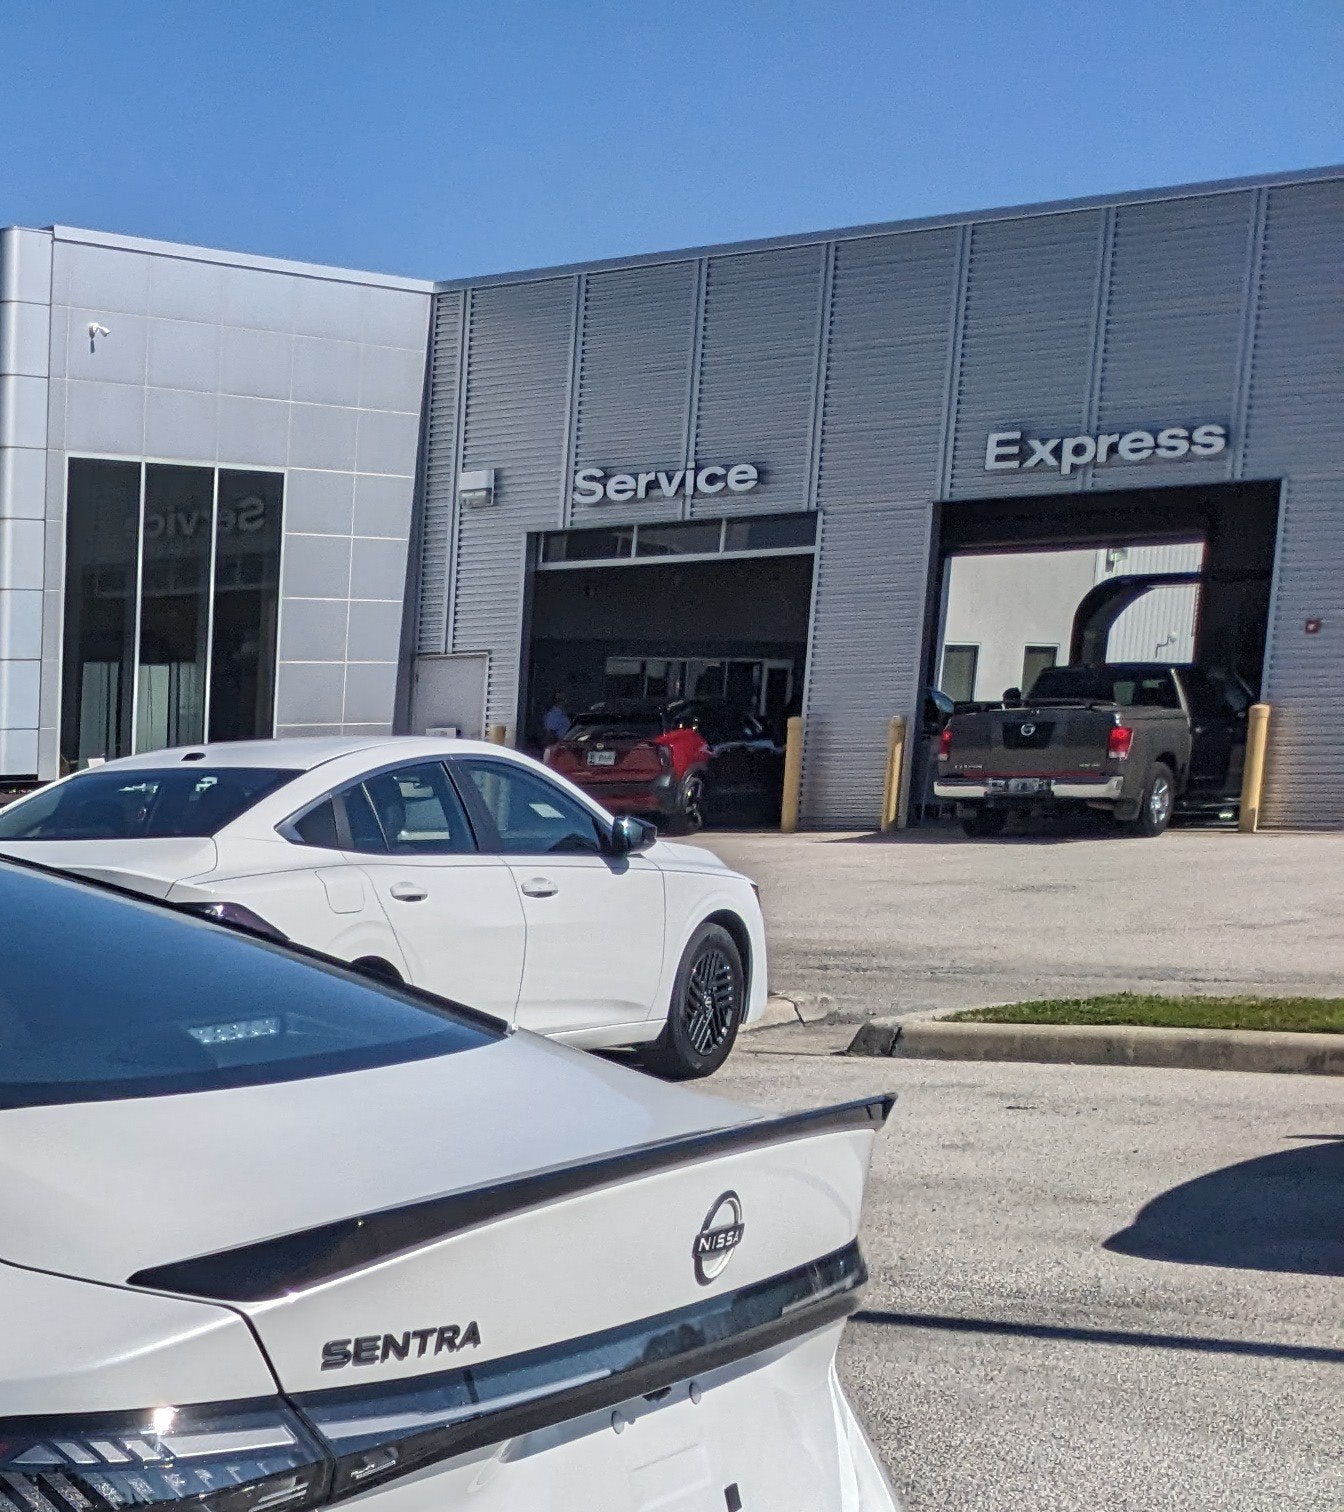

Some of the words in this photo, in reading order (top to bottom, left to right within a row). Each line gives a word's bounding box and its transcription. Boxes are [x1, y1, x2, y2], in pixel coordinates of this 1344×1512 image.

[985, 424, 1226, 475] Express
[572, 463, 758, 504] Service
[698, 1224, 743, 1252] NISSA
[320, 1320, 481, 1371] SENTRA
